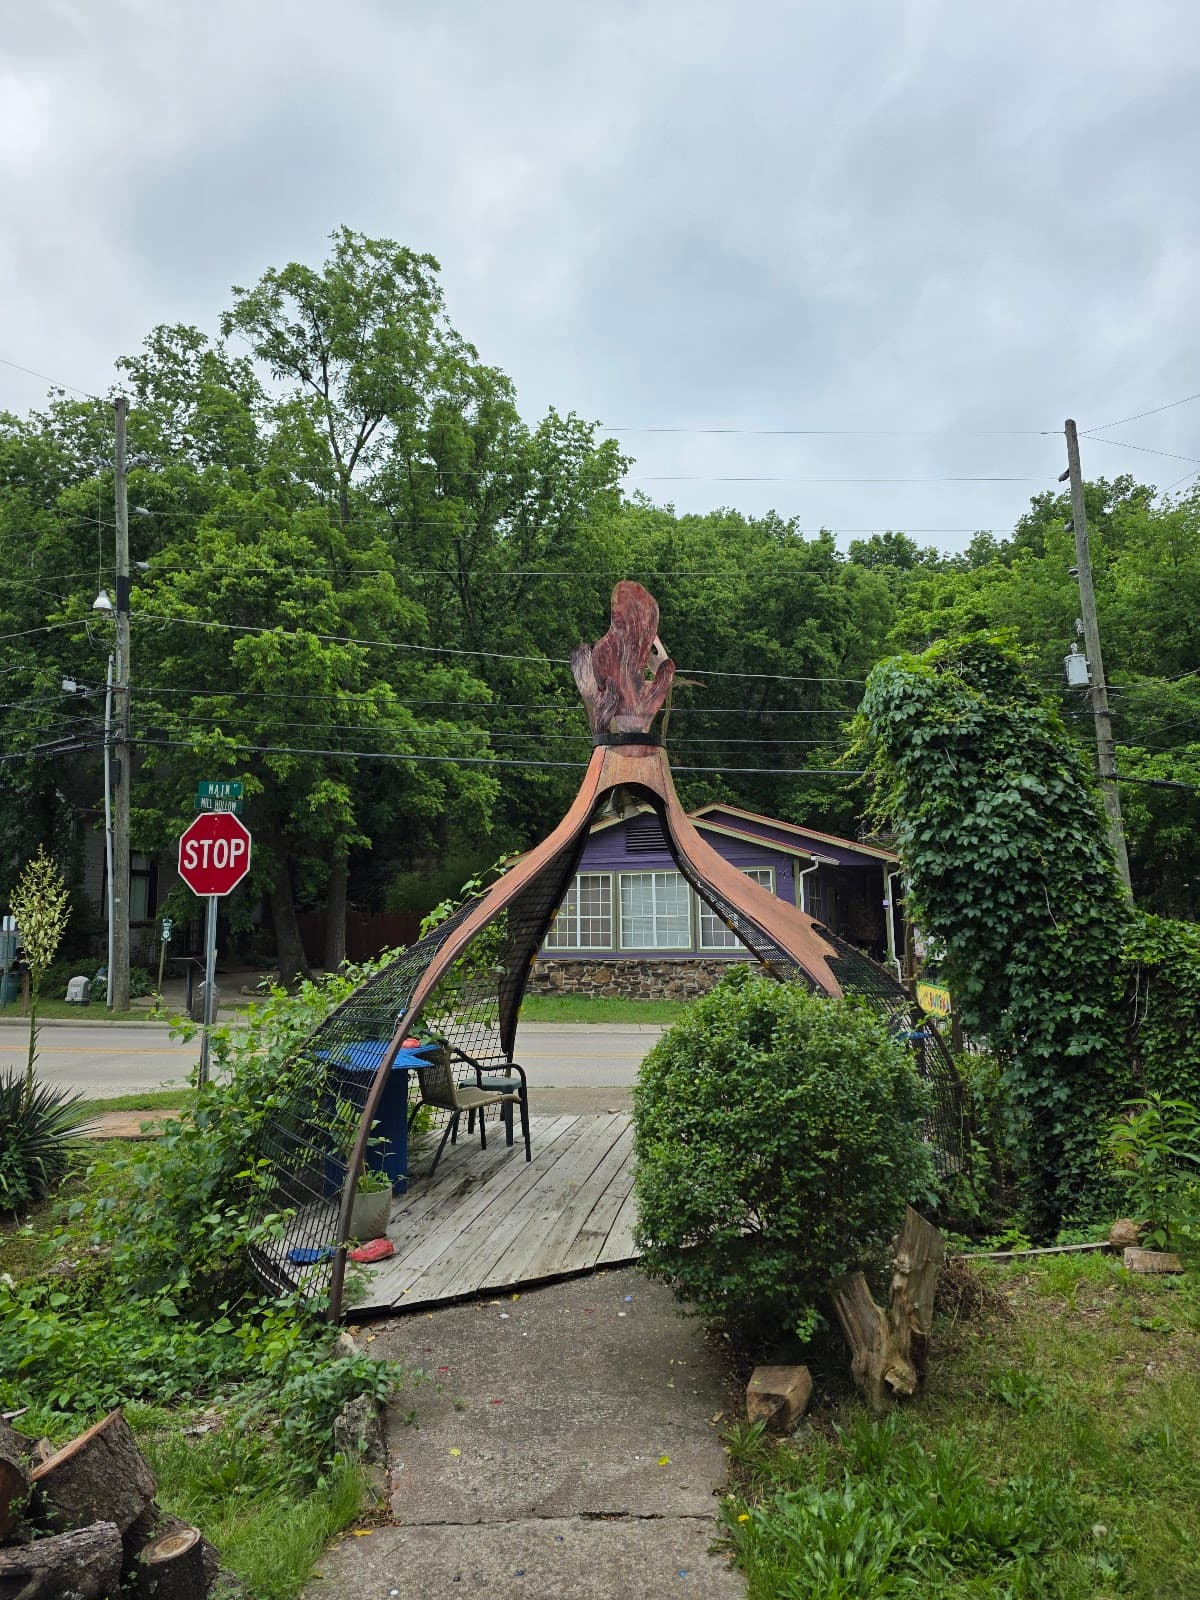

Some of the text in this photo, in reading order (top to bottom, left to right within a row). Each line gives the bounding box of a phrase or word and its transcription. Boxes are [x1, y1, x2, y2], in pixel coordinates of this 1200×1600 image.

[208, 783, 230, 795] MAIN
[200, 797, 237, 812] MILL HOLLOW
[183, 838, 246, 870] STOP
